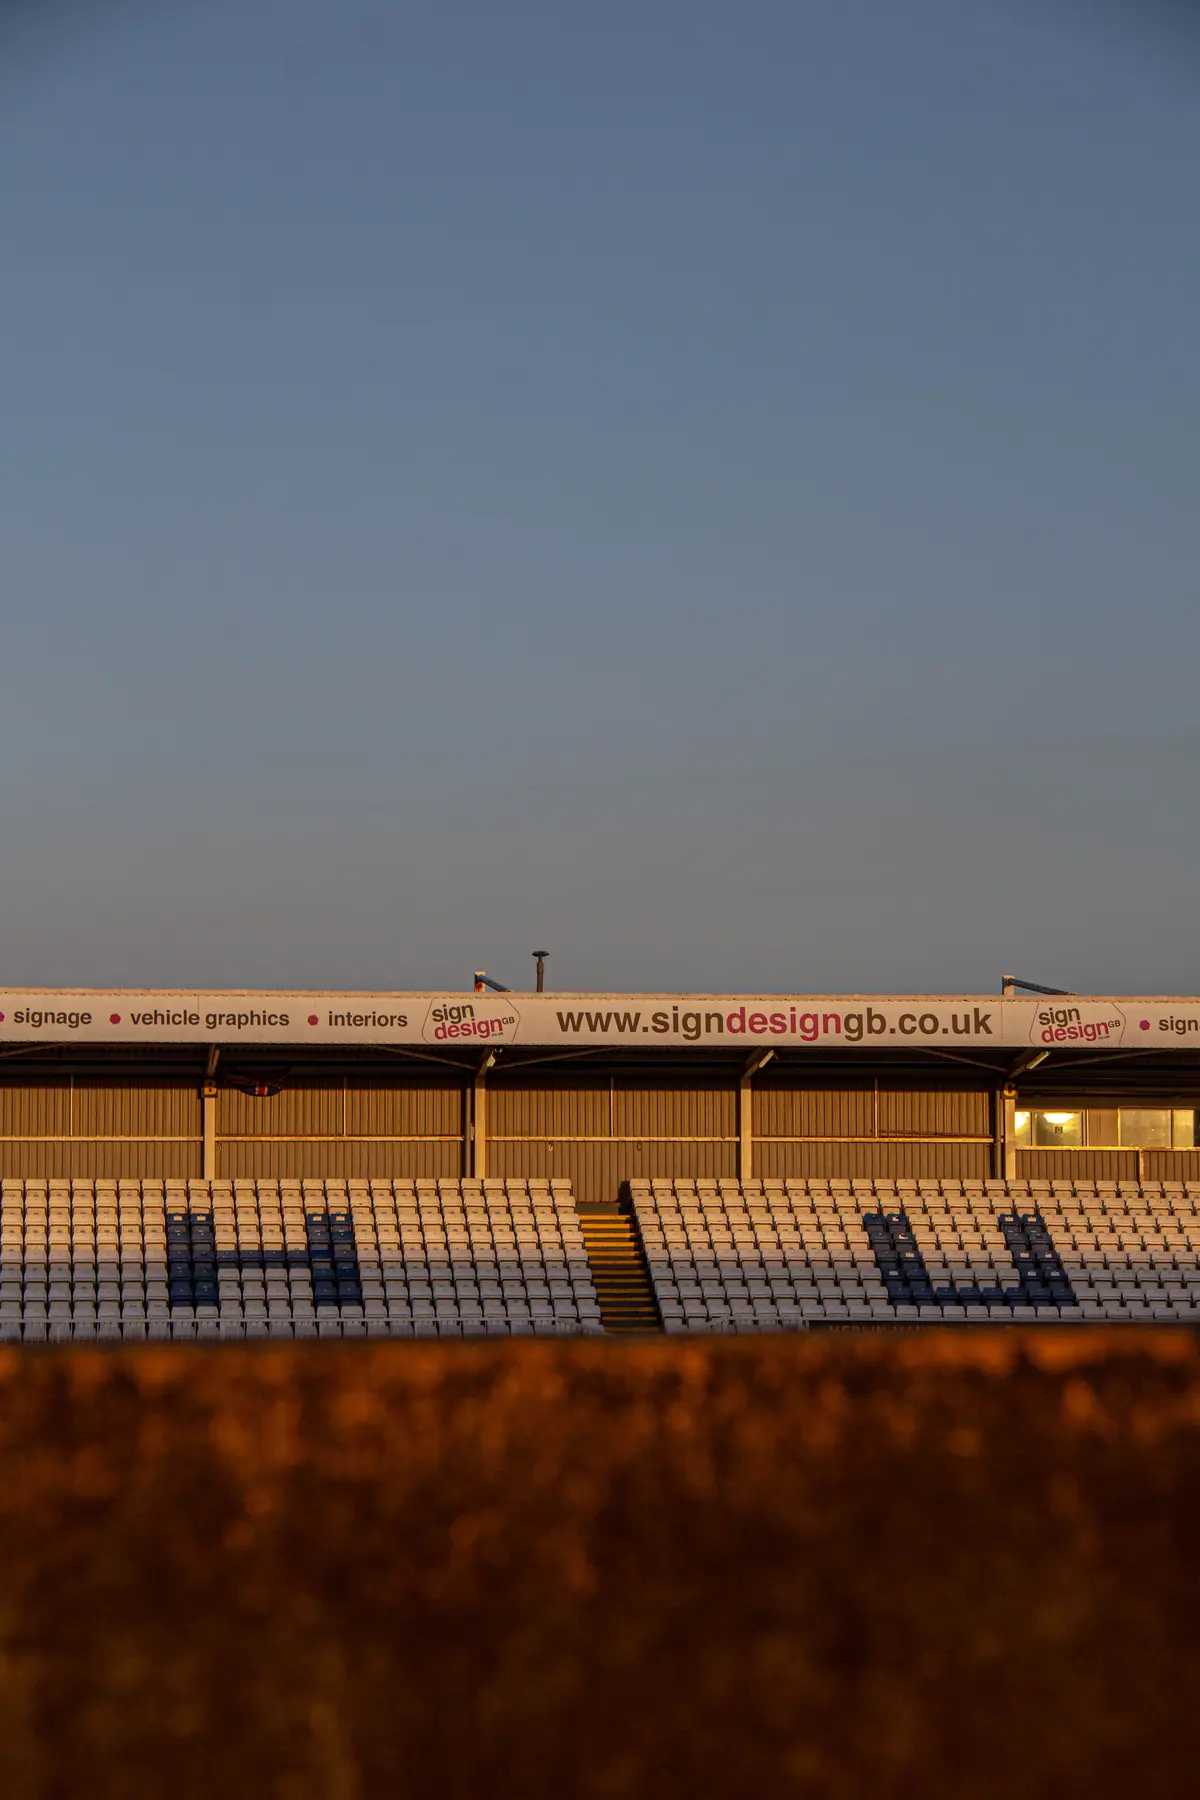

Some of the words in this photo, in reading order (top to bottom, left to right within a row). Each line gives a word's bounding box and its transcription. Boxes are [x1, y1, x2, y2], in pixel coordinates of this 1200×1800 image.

[13, 1008, 92, 1028] signage
[130, 1009, 200, 1026] vehicle
[205, 1010, 290, 1029] graphics
[328, 1011, 408, 1027] interiors
[432, 1004, 475, 1024] sign
[557, 1006, 993, 1041] www.signdesigngb.co.uk
[1038, 1007, 1081, 1028] sign
[434, 1018, 503, 1040] design
[1041, 1021, 1110, 1043] design
[1158, 1015, 1200, 1036] sign
[1003, 1082, 1017, 1097] C
